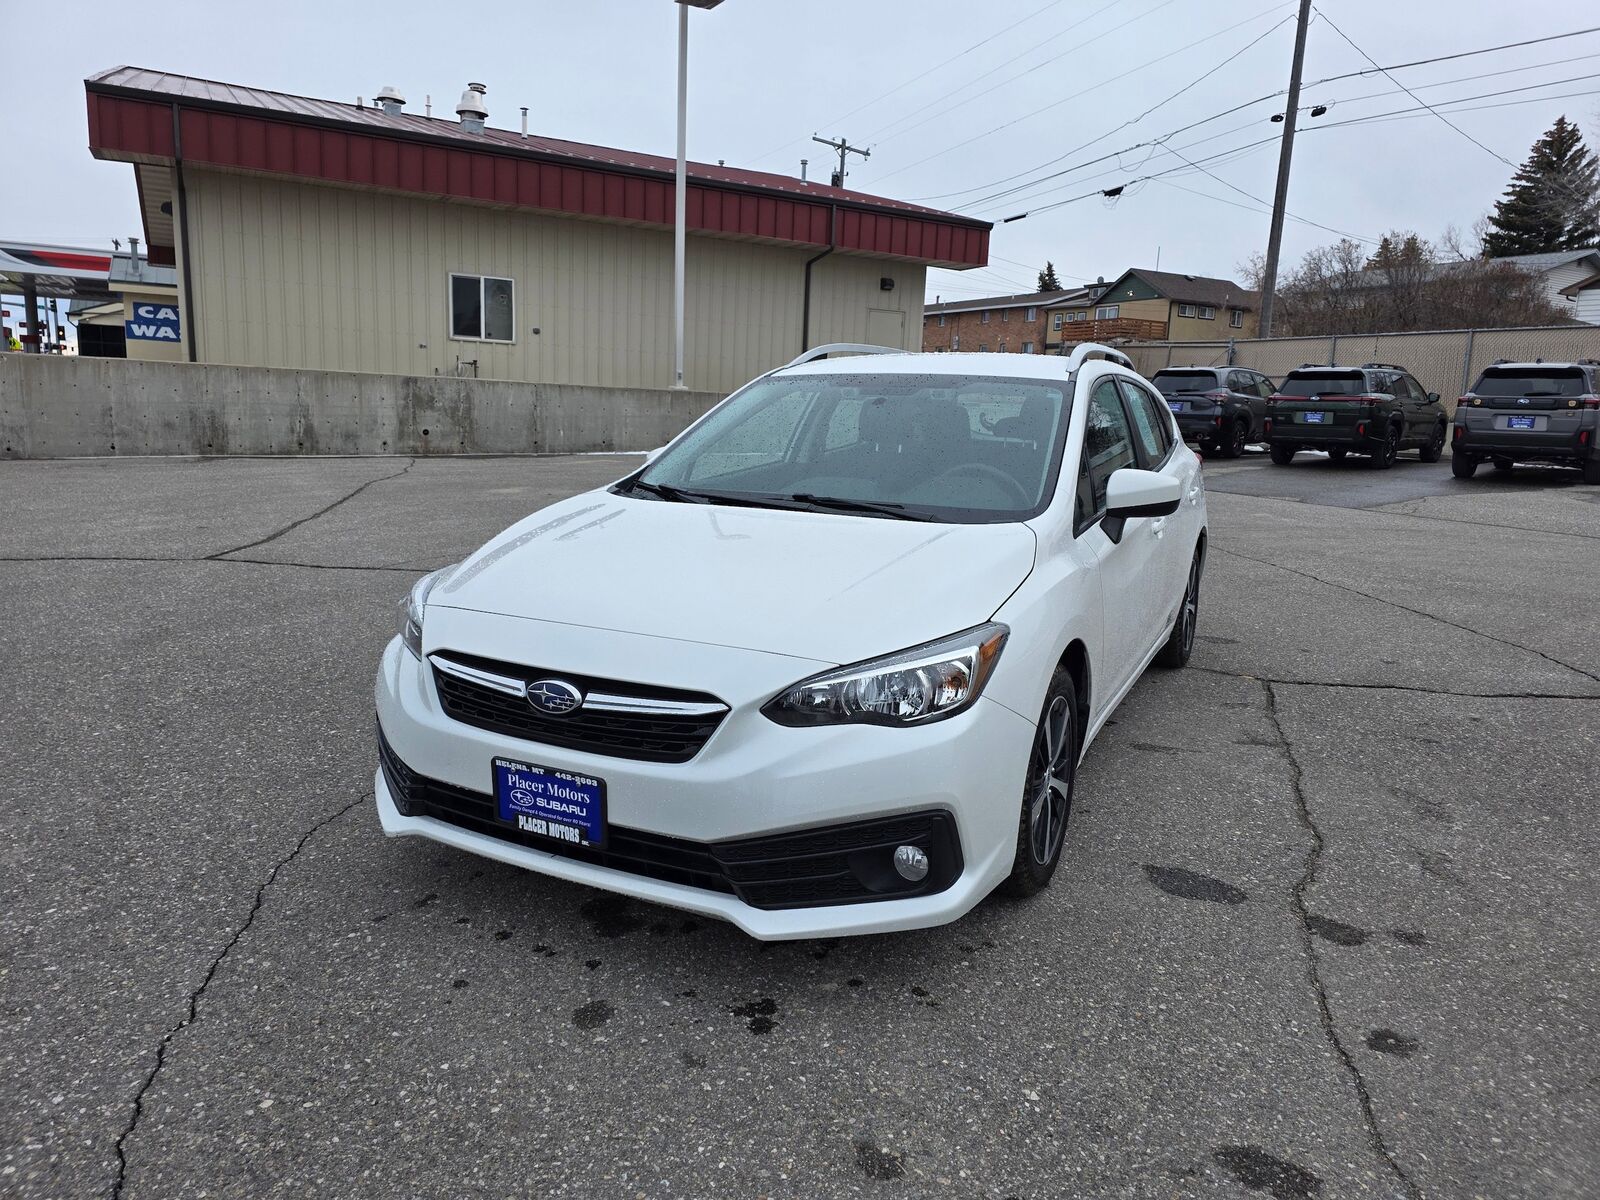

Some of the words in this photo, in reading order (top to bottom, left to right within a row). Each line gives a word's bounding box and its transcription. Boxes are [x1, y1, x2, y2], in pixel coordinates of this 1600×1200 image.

[138, 306, 180, 321] CA
[130, 324, 182, 339] WA
[531, 766, 545, 775] MT
[507, 774, 544, 793] Placer
[547, 783, 590, 804] Motors
[508, 803, 521, 811] Family
[538, 811, 556, 819] Operated
[536, 797, 587, 817] SUBARU
[518, 814, 548, 836] PLACER
[548, 822, 580, 843] MOTORS
